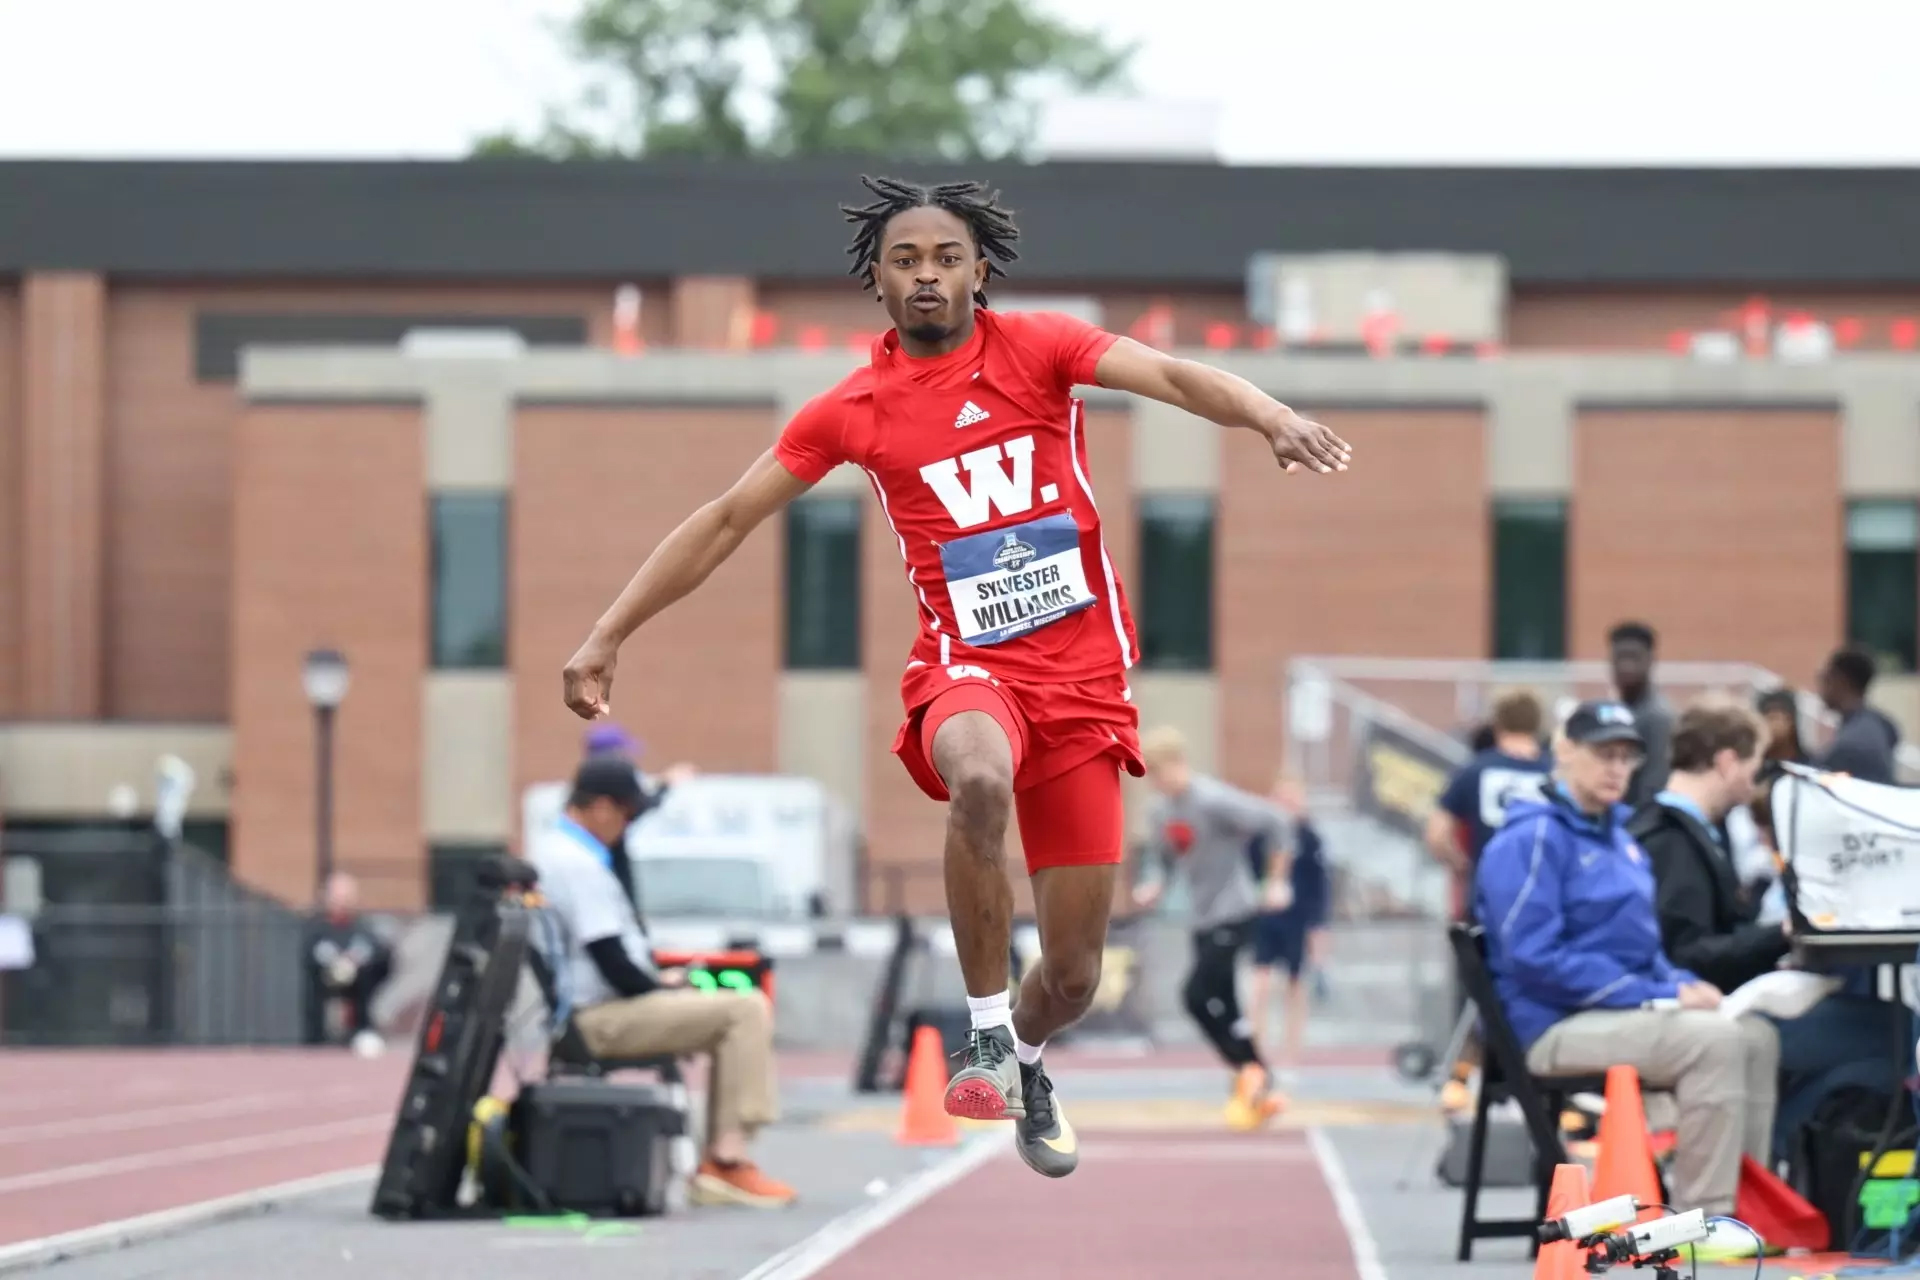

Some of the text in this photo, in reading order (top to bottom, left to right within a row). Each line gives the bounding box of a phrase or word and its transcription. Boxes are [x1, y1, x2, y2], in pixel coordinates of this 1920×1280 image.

[955, 411, 990, 428] adidas
[919, 435, 1059, 529] W.
[976, 564, 1060, 600] SYLVESTER
[972, 584, 1076, 631] WILLIAMS
[1829, 848, 1904, 874] SPORT
